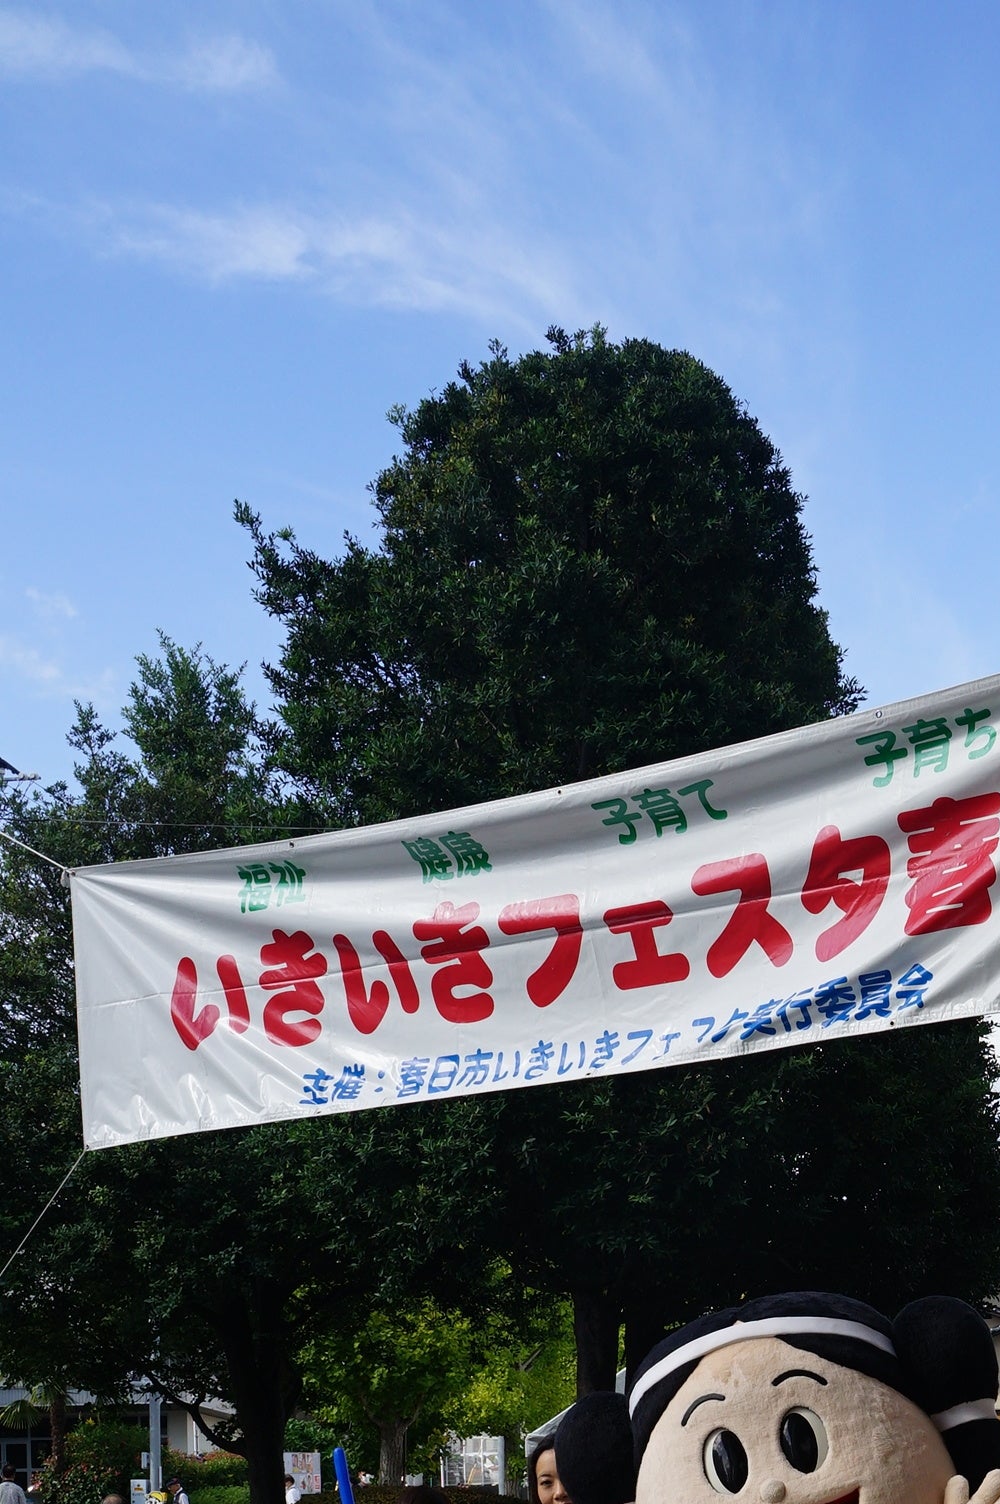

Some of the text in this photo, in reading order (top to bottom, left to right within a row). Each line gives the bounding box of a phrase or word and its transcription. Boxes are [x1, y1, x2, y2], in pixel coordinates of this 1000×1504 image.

[238, 707, 998, 914] 福祉 健康 子育て 子育ち
